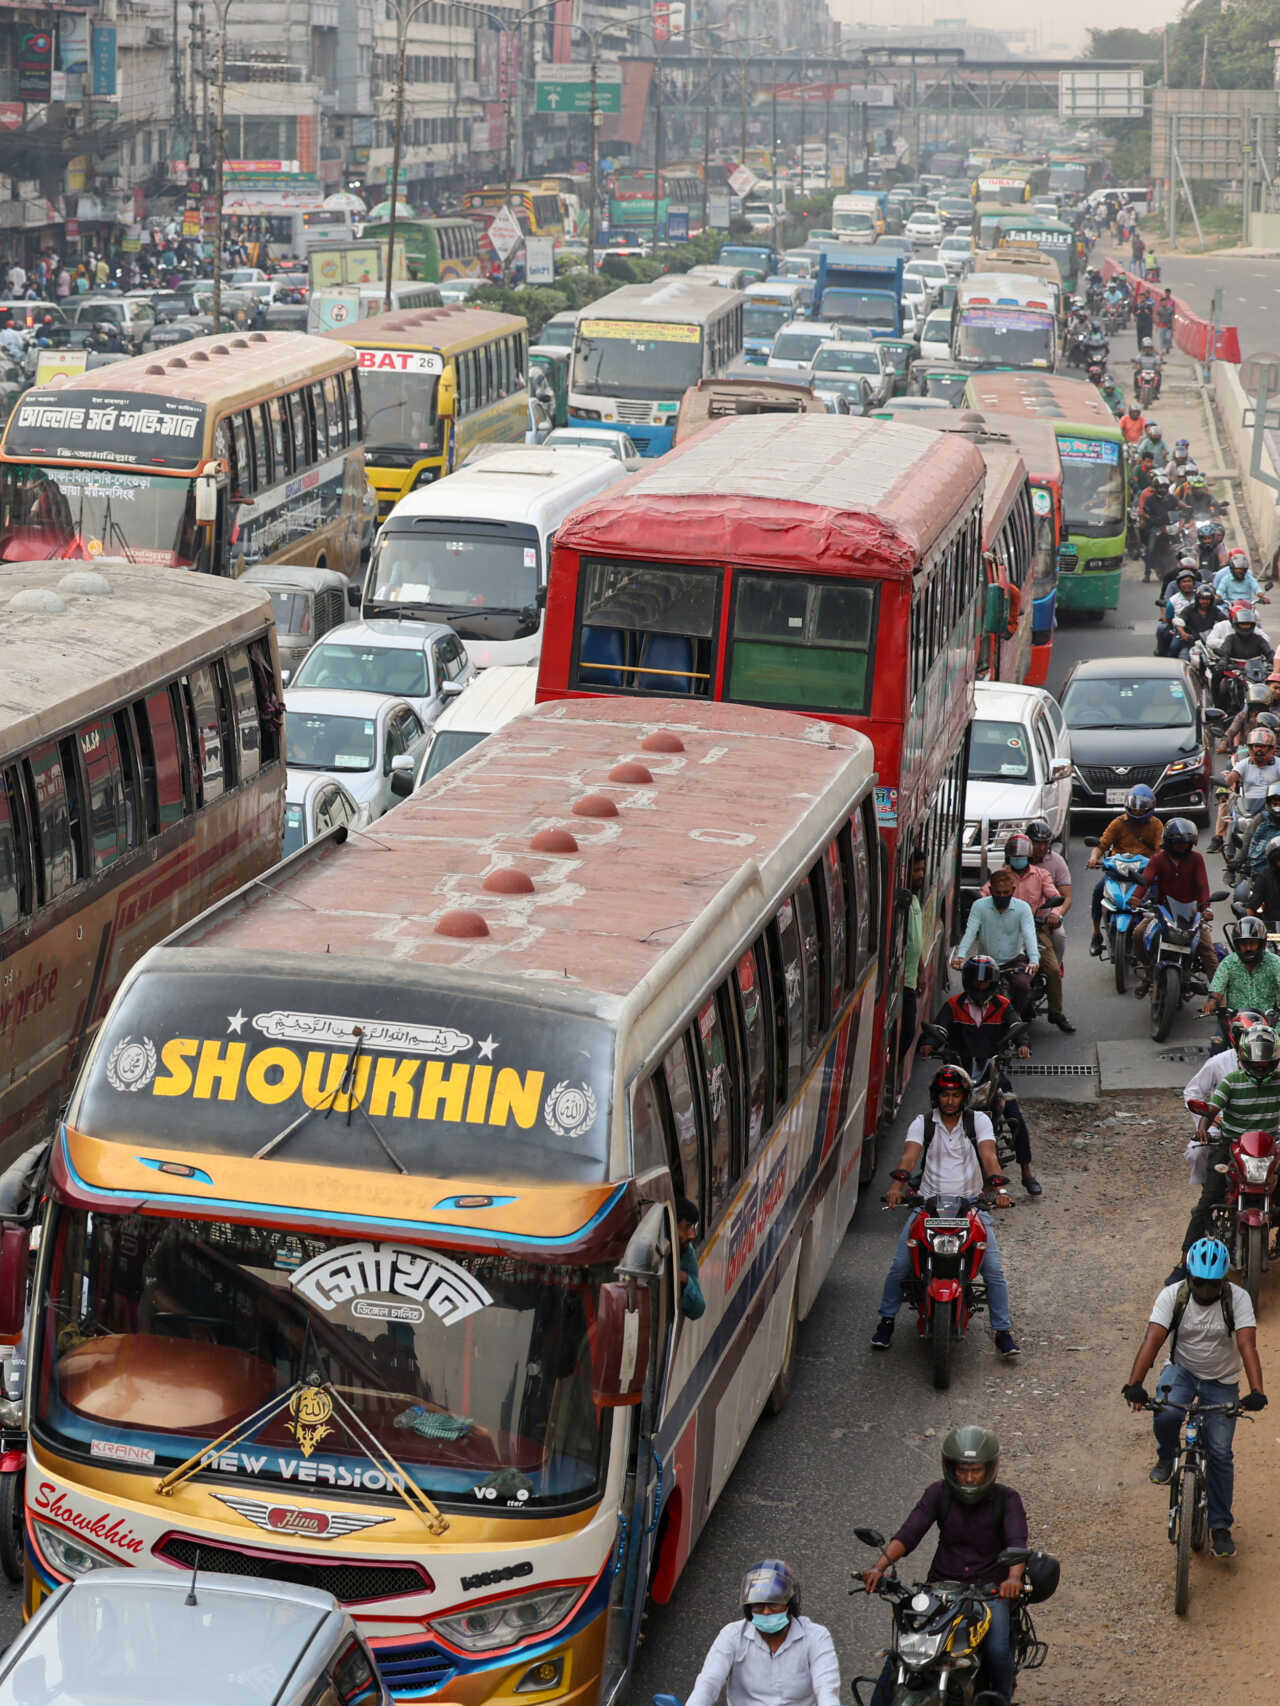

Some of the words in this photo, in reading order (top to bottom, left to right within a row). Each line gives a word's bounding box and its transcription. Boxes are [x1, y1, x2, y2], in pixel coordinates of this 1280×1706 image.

[419, 357, 434, 369] 26
[18, 406, 86, 429] আল্লাহ
[153, 1036, 545, 1129] SHOWKHIN
[356, 1302, 388, 1318] ডিজেল
[91, 1440, 153, 1462] KRANK
[34, 1482, 145, 1554] Showkhin
[278, 1510, 320, 1531] Hino
